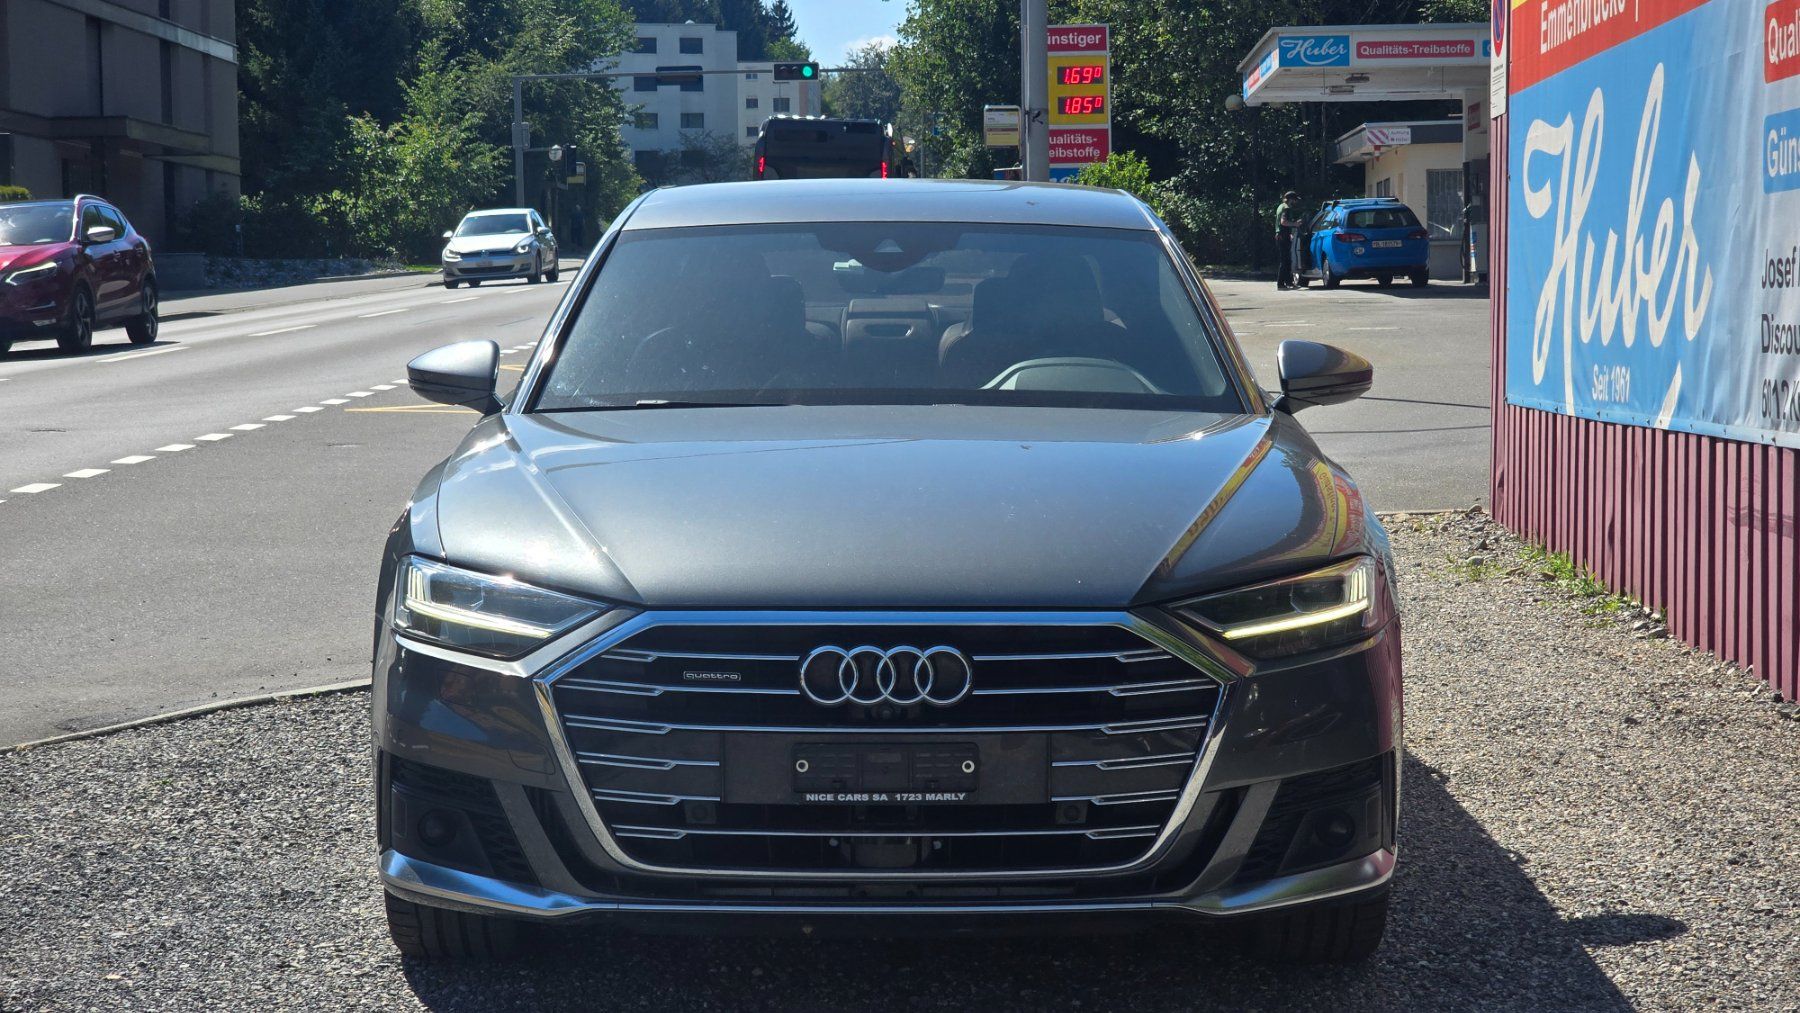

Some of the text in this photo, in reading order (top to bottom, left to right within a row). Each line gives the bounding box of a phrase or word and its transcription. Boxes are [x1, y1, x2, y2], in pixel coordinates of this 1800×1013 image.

[1280, 38, 1348, 65] Huber
[1360, 43, 1471, 55] Qualitäts-Treibstoffe
[1048, 133, 1098, 145] ualitäts-
[1048, 146, 1101, 158] eibstoffe
[1523, 62, 1713, 429] Huber
[1761, 245, 1797, 289] Josef
[1592, 363, 1631, 403] Seit 1961
[685, 672, 739, 680] quattro
[805, 793, 966, 801] NICE CARS SA 1723 MARLY
